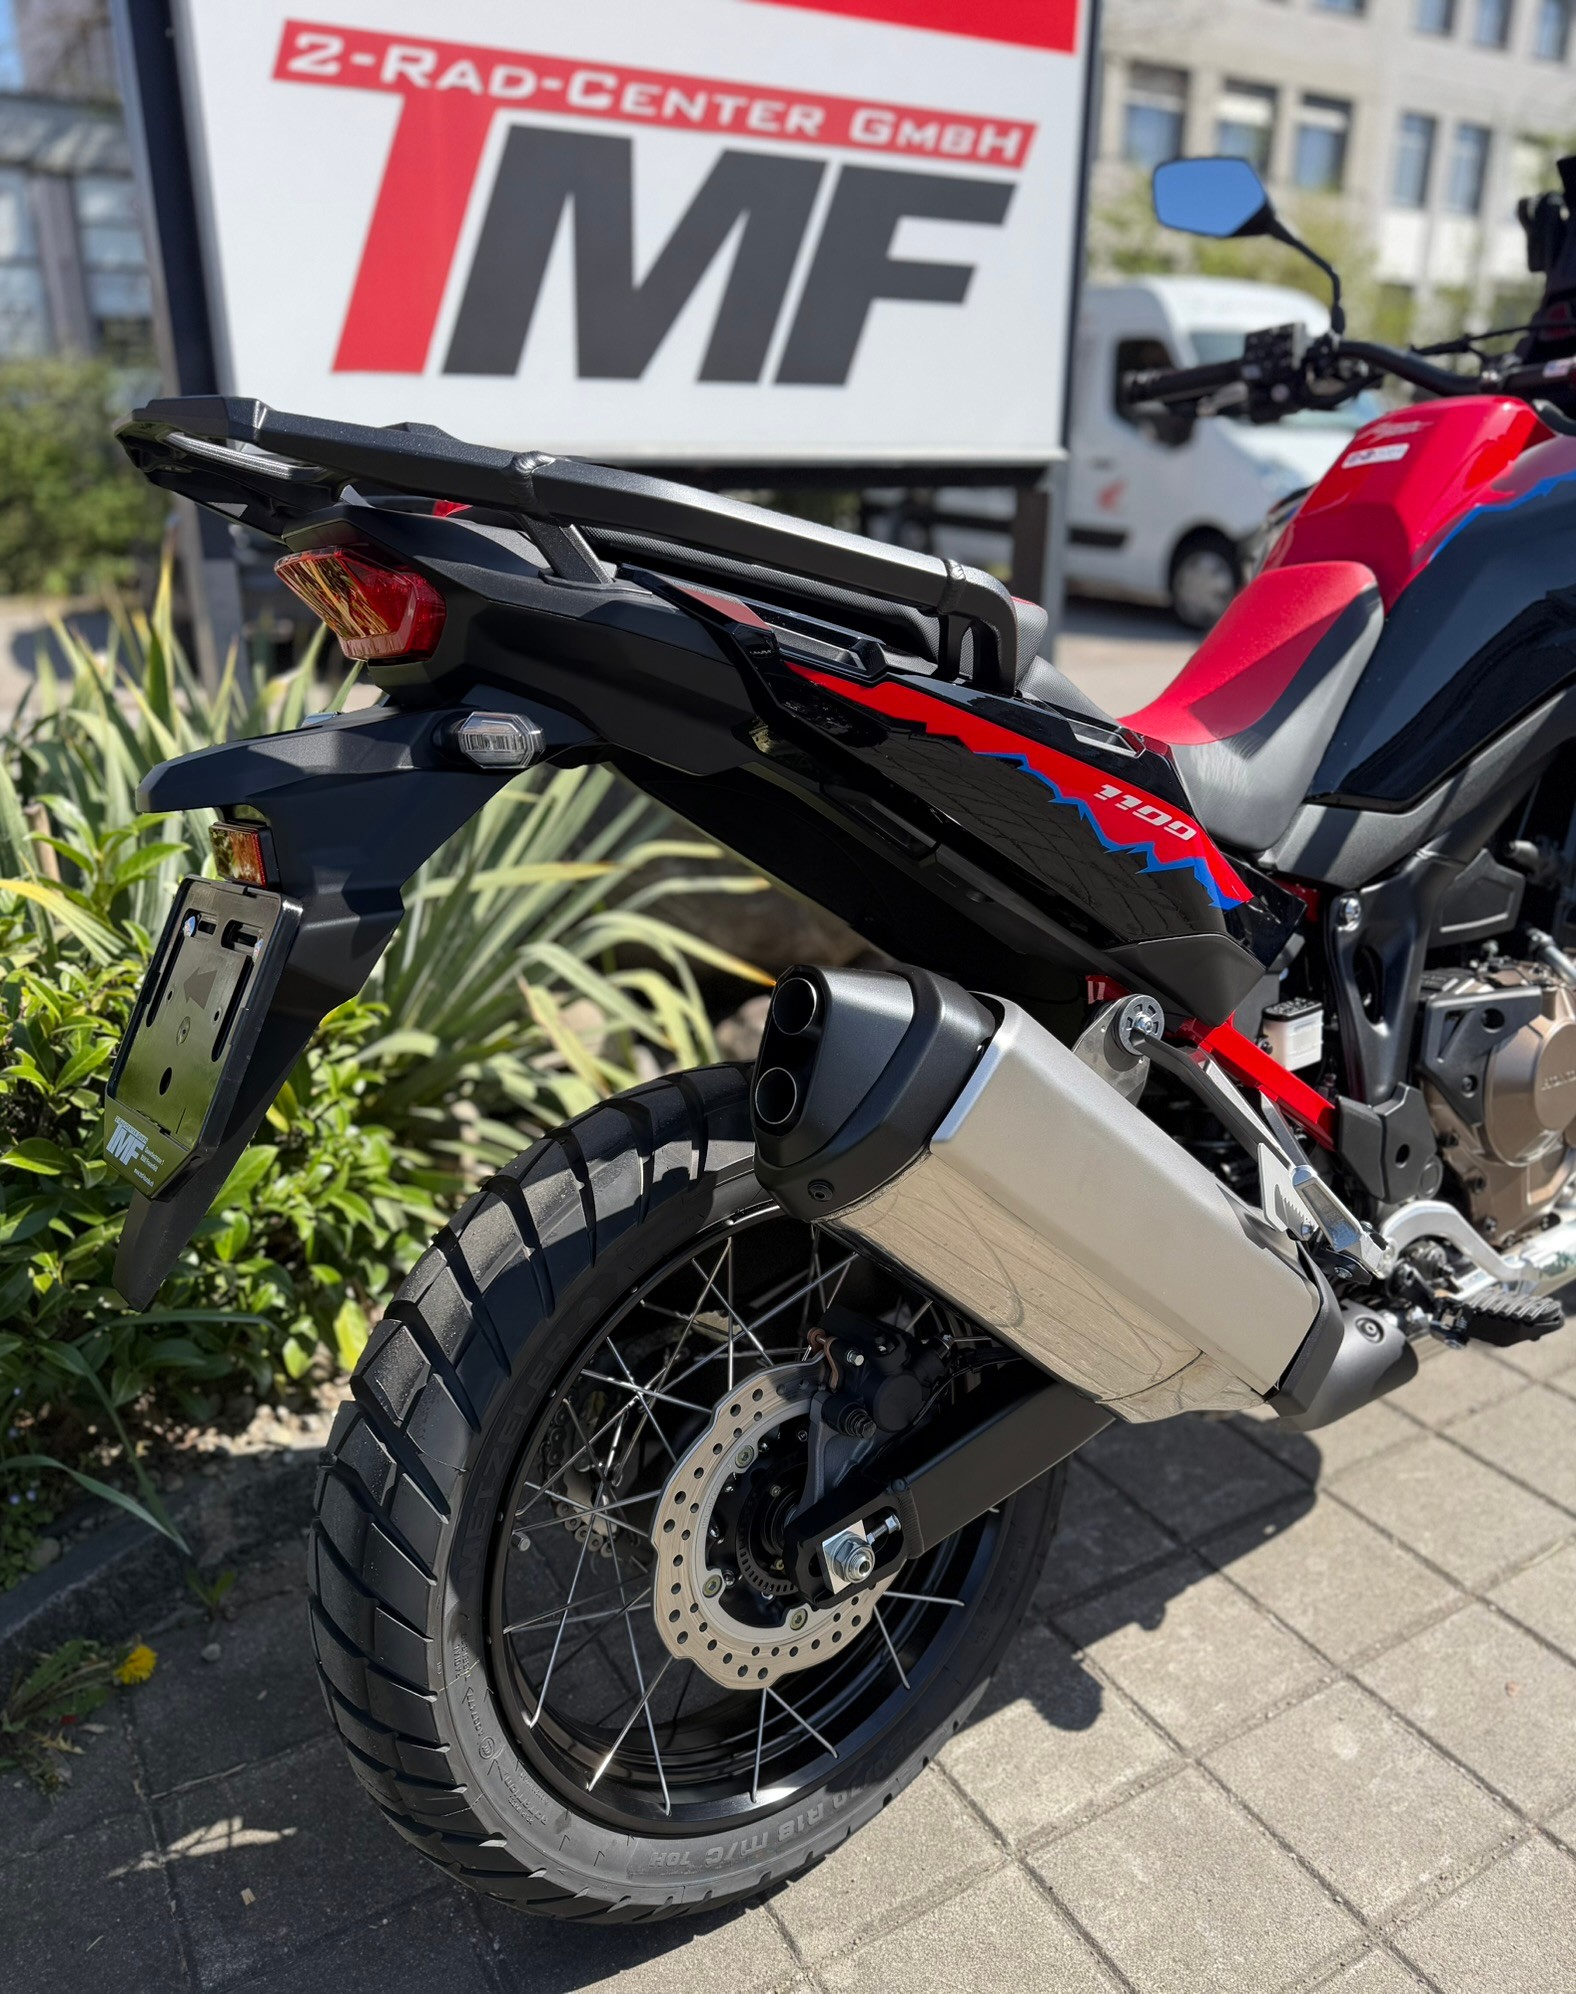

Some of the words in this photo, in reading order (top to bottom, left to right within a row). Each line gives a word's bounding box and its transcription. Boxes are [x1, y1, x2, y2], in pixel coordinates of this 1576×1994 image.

[285, 31, 825, 138] 2-RAD-CENTER
[331, 90, 1018, 387] TMF
[1093, 784, 1197, 841] 1100
[106, 1123, 147, 1166] TMF
[456, 1331, 571, 1580] METZELER
[778, 1802, 824, 1842] R18
[649, 1852, 690, 1867] 70H
[705, 1831, 769, 1866] M/C
